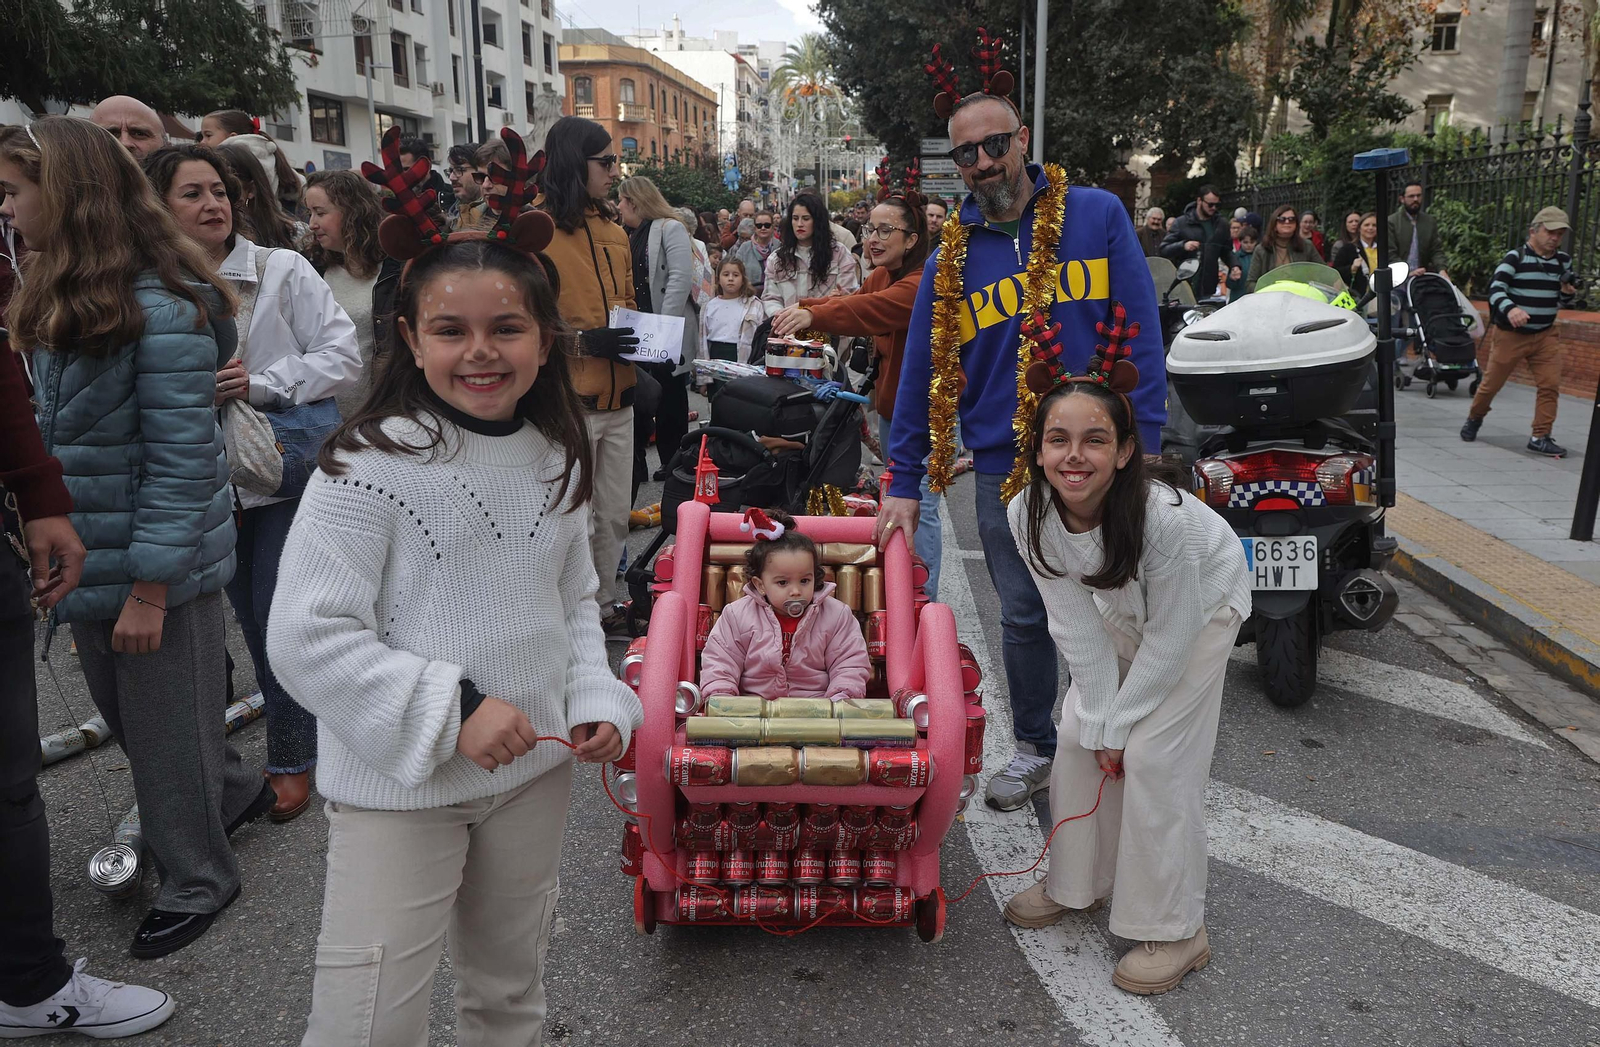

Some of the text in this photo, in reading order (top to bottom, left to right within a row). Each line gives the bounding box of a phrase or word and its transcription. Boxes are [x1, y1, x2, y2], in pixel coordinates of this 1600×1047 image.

[967, 258, 1092, 331] POO
[634, 345, 669, 360] REMIO
[1255, 540, 1315, 561] 6636
[1256, 566, 1300, 587] HWT
[681, 748, 692, 786] Cruzcamp
[910, 750, 920, 788] uzcampo
